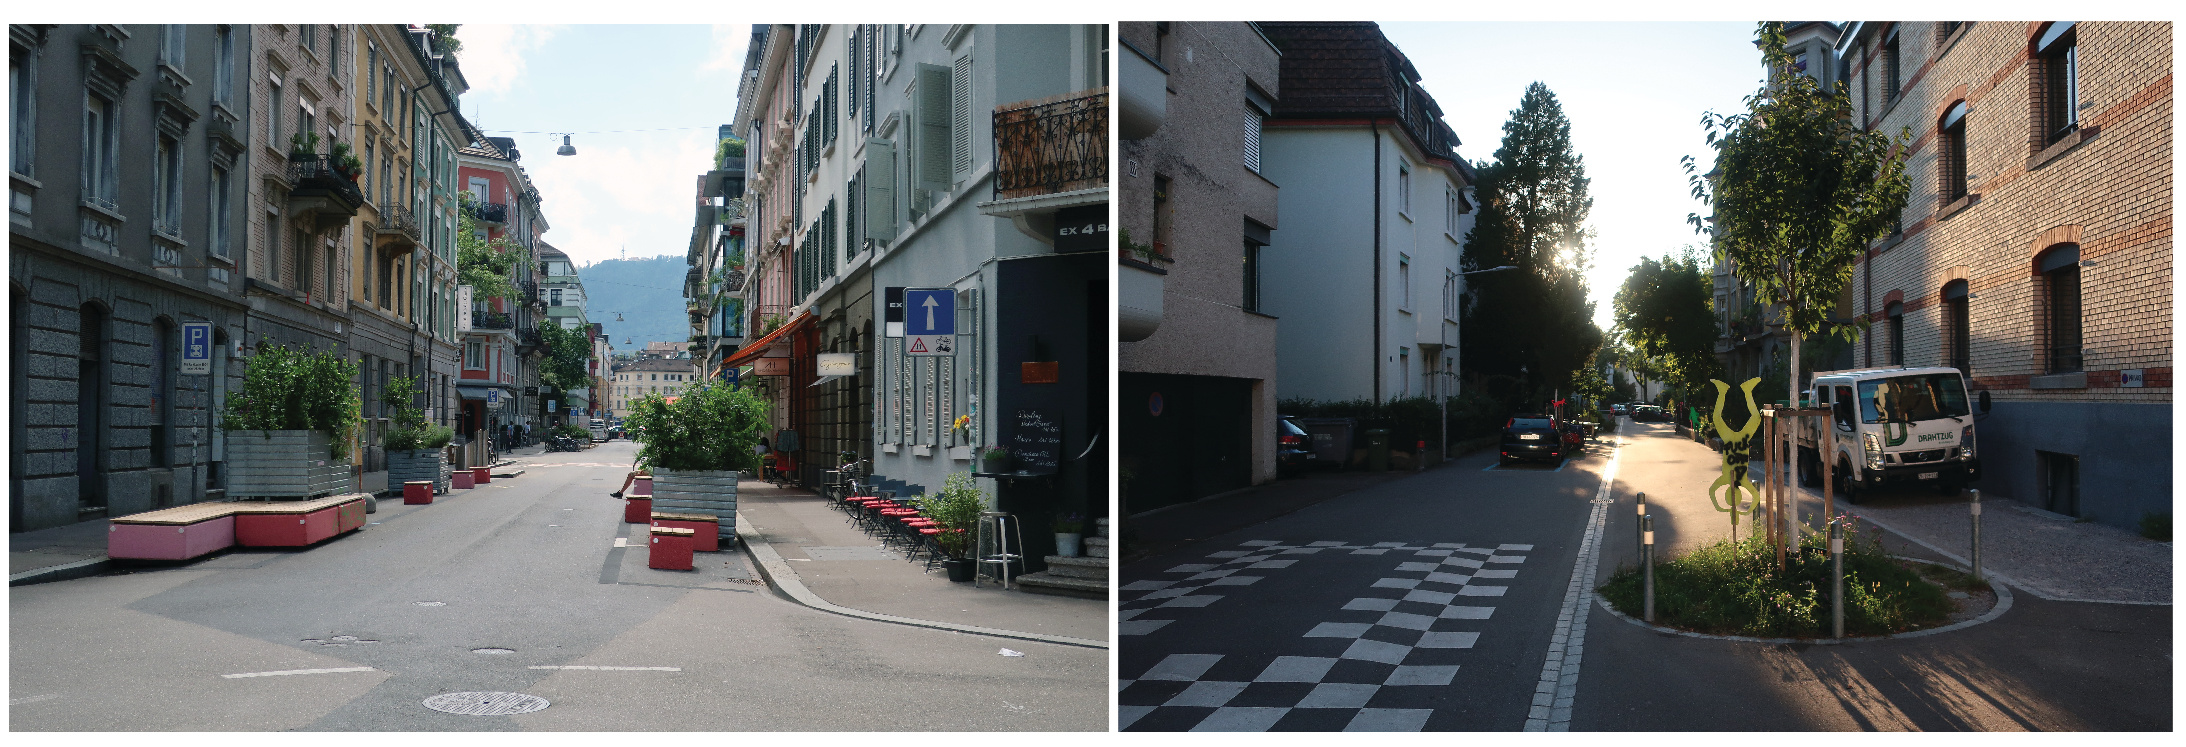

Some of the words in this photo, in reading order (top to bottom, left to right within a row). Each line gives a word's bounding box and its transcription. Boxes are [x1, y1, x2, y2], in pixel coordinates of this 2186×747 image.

[1060, 227, 1077, 235] EX
[1082, 223, 1094, 235] 4
[191, 328, 203, 345] P
[726, 369, 735, 381] P
[1917, 431, 1954, 443] DRAHTZUG
